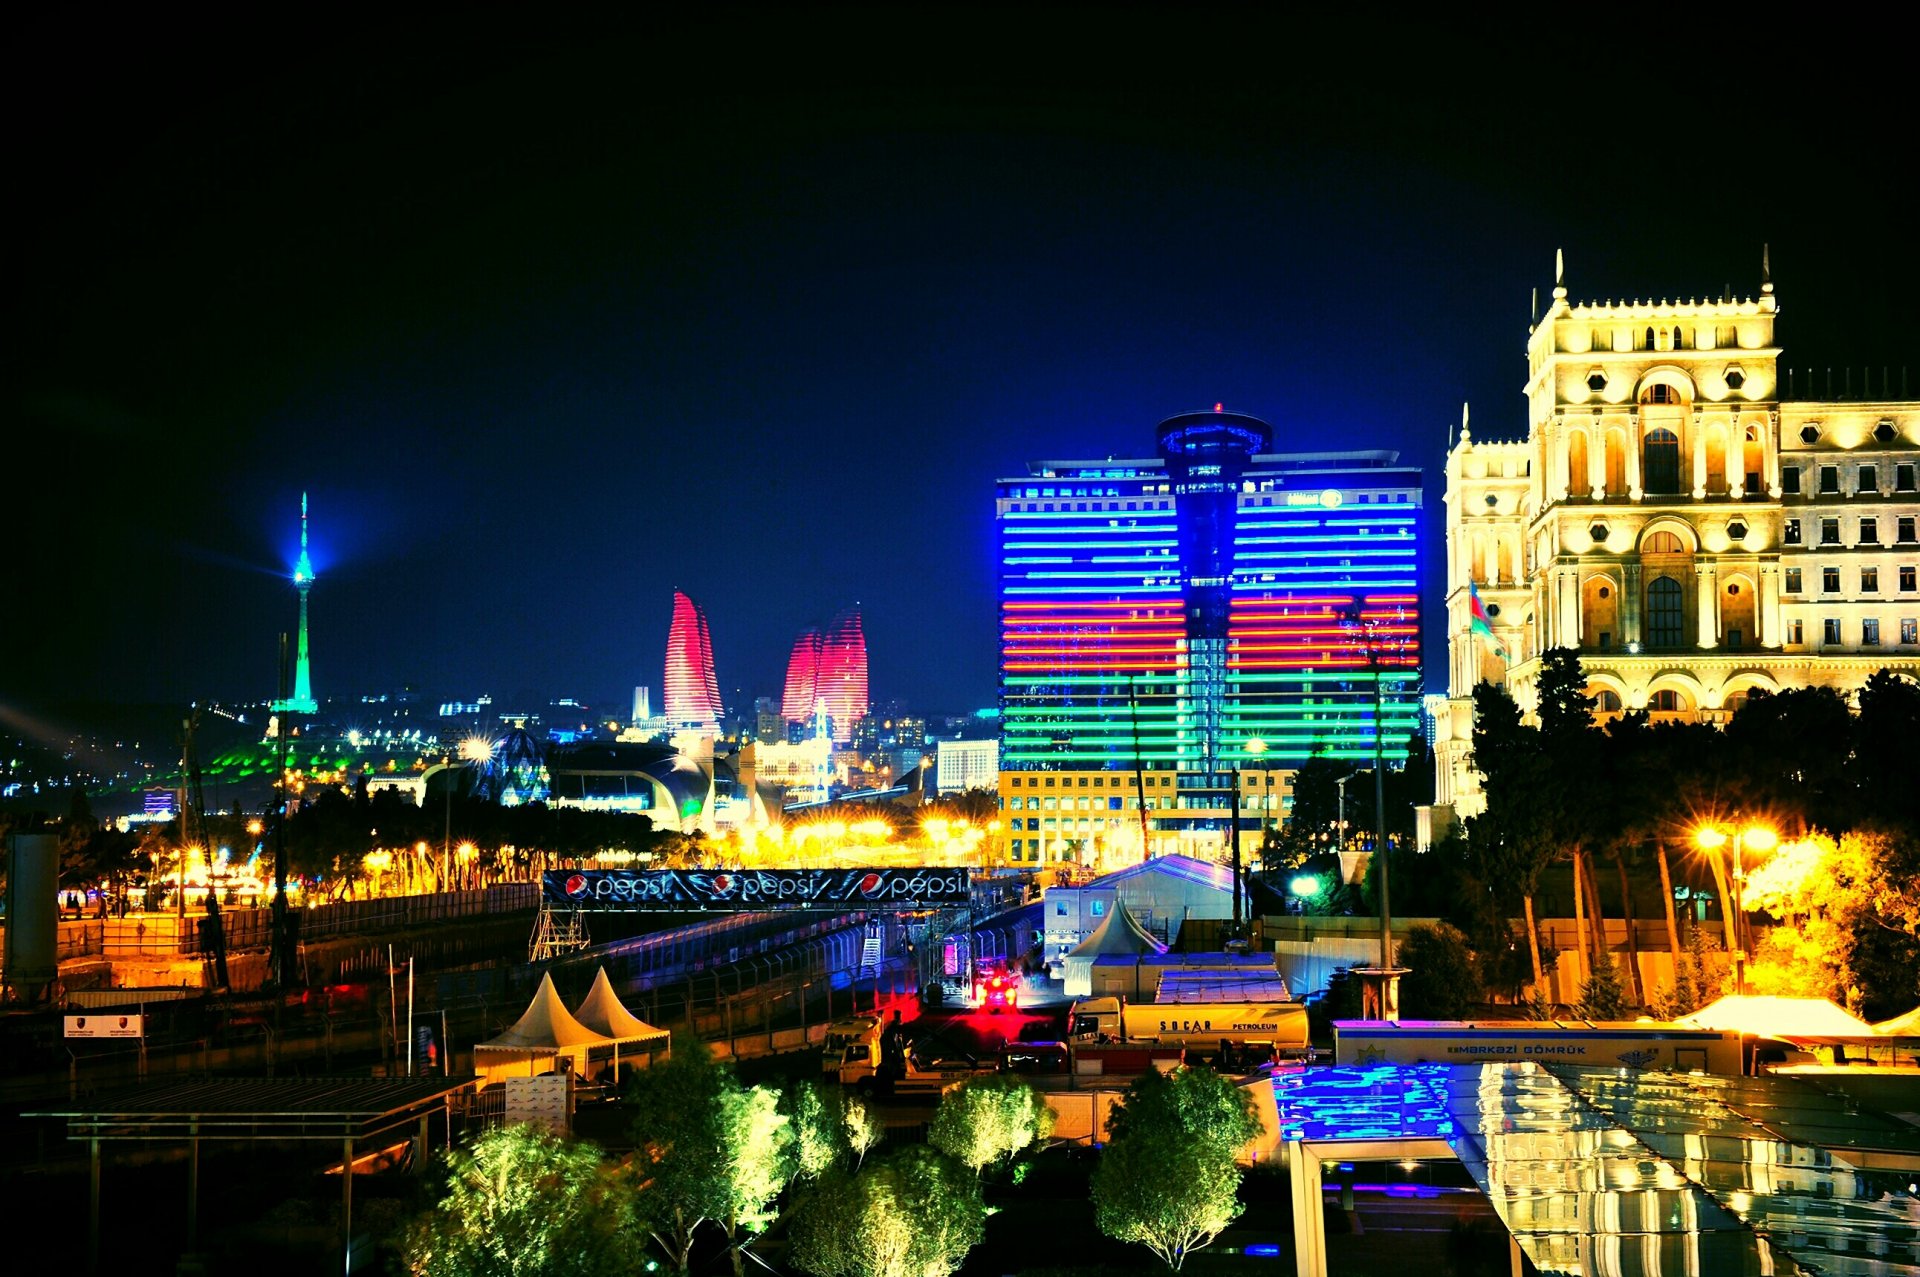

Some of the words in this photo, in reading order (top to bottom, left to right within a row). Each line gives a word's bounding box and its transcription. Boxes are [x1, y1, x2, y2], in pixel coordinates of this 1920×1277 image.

[596, 874, 666, 900] pepsi
[743, 873, 814, 901] pepsi
[890, 872, 962, 898] pepsi
[1160, 1020, 1211, 1035] SOCAR
[1232, 1023, 1278, 1031] PETROLEUM
